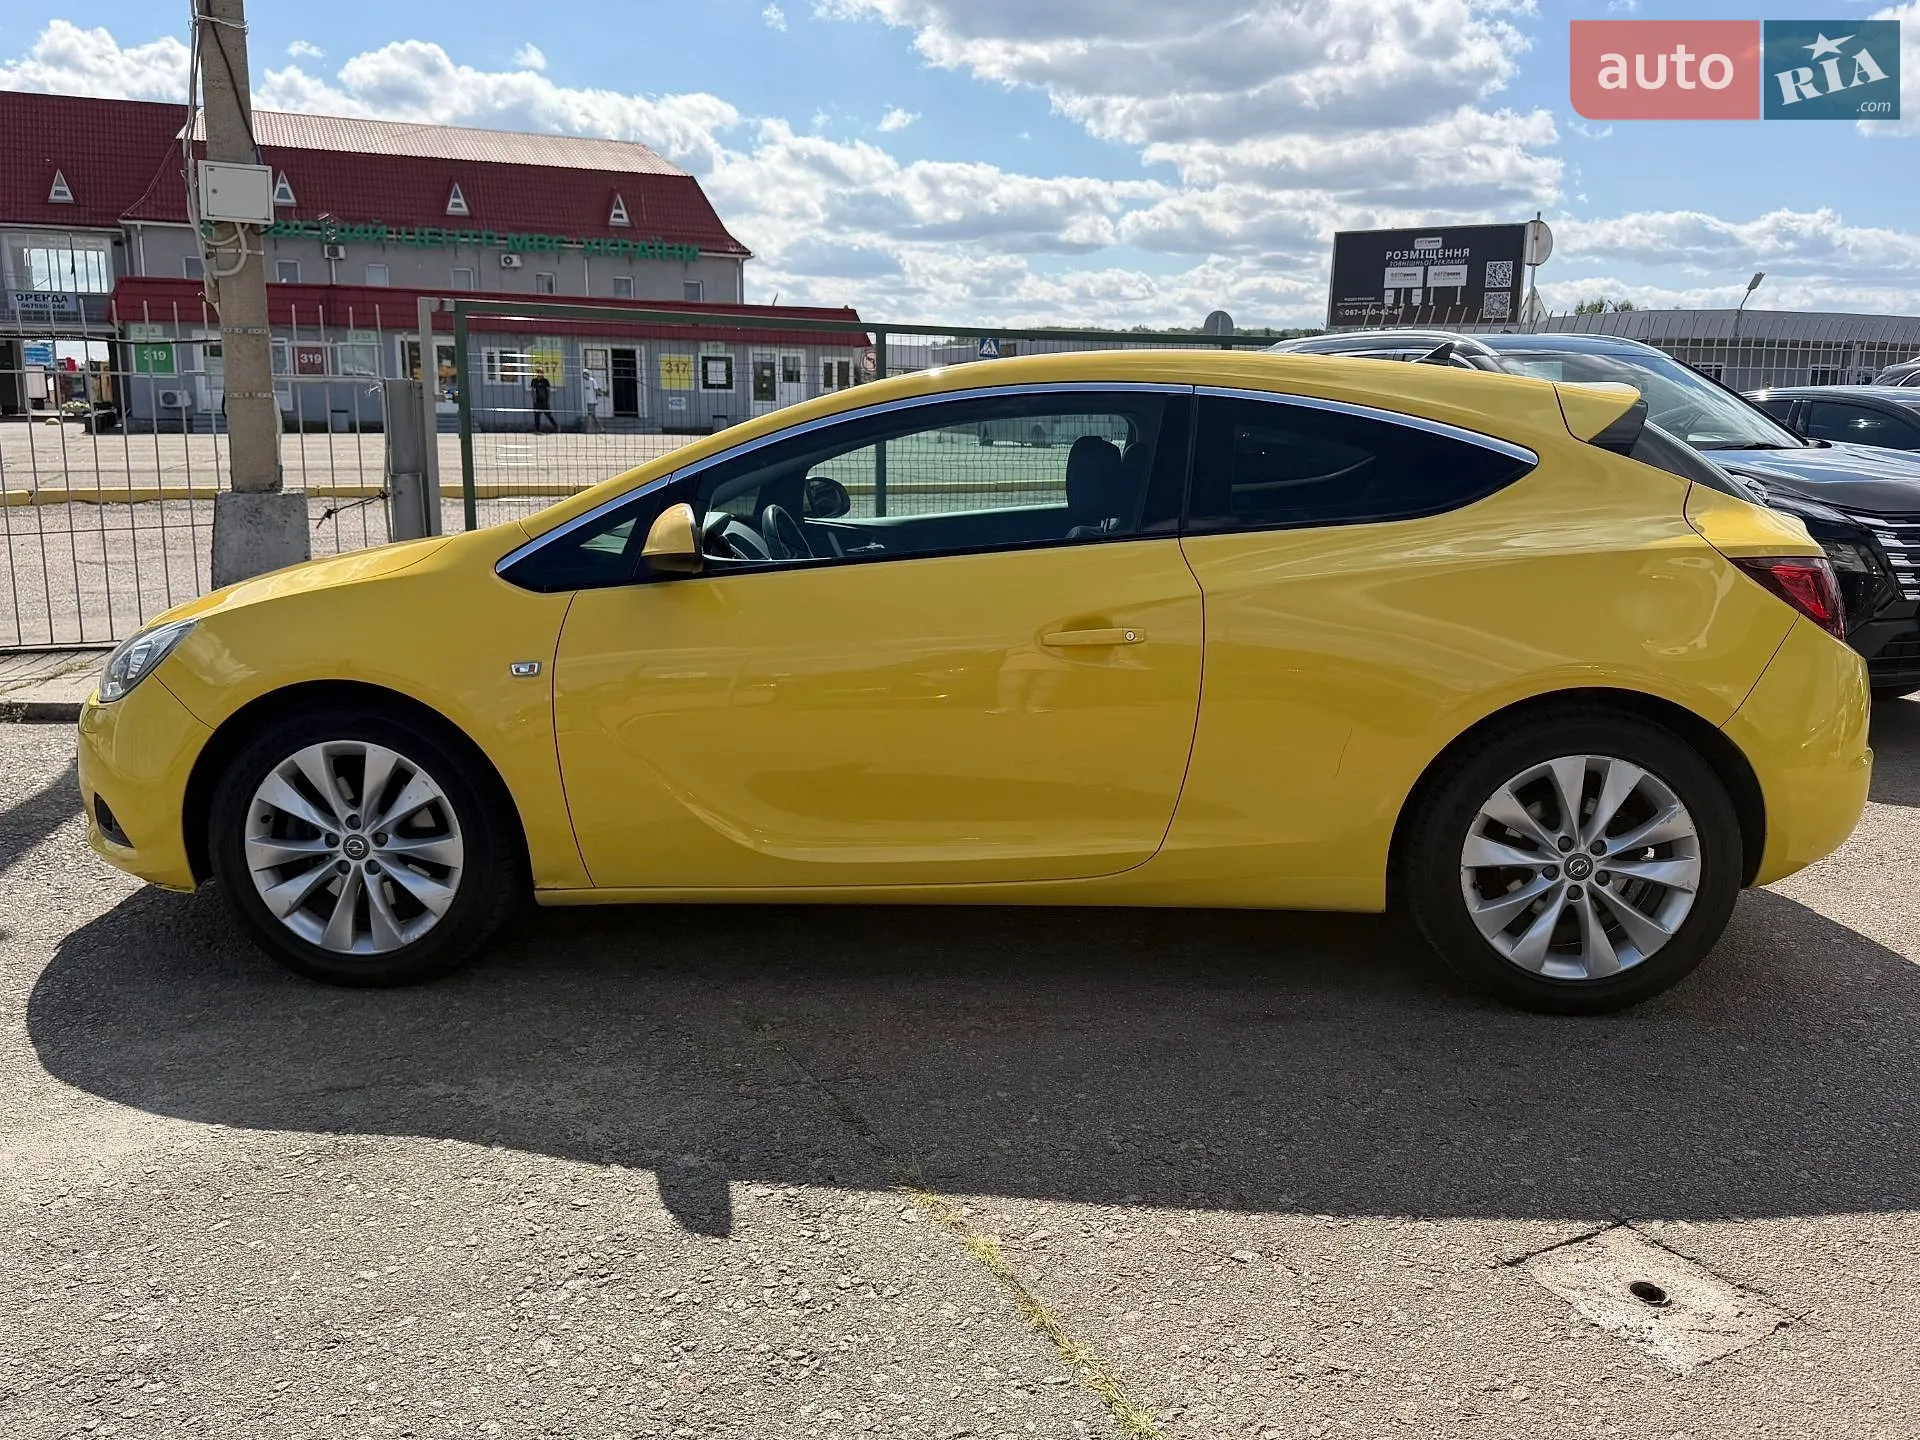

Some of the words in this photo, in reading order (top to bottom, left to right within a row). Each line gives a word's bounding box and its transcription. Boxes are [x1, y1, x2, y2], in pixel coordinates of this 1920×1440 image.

[399, 226, 497, 249] ЦЕНТР
[507, 232, 568, 256] МВС
[582, 236, 701, 263] УКРАЇНИ
[1385, 248, 1470, 261] РОЗМІЩЕННЯ
[144, 350, 167, 361] 319
[300, 353, 322, 363] 319
[665, 360, 688, 374] 317
